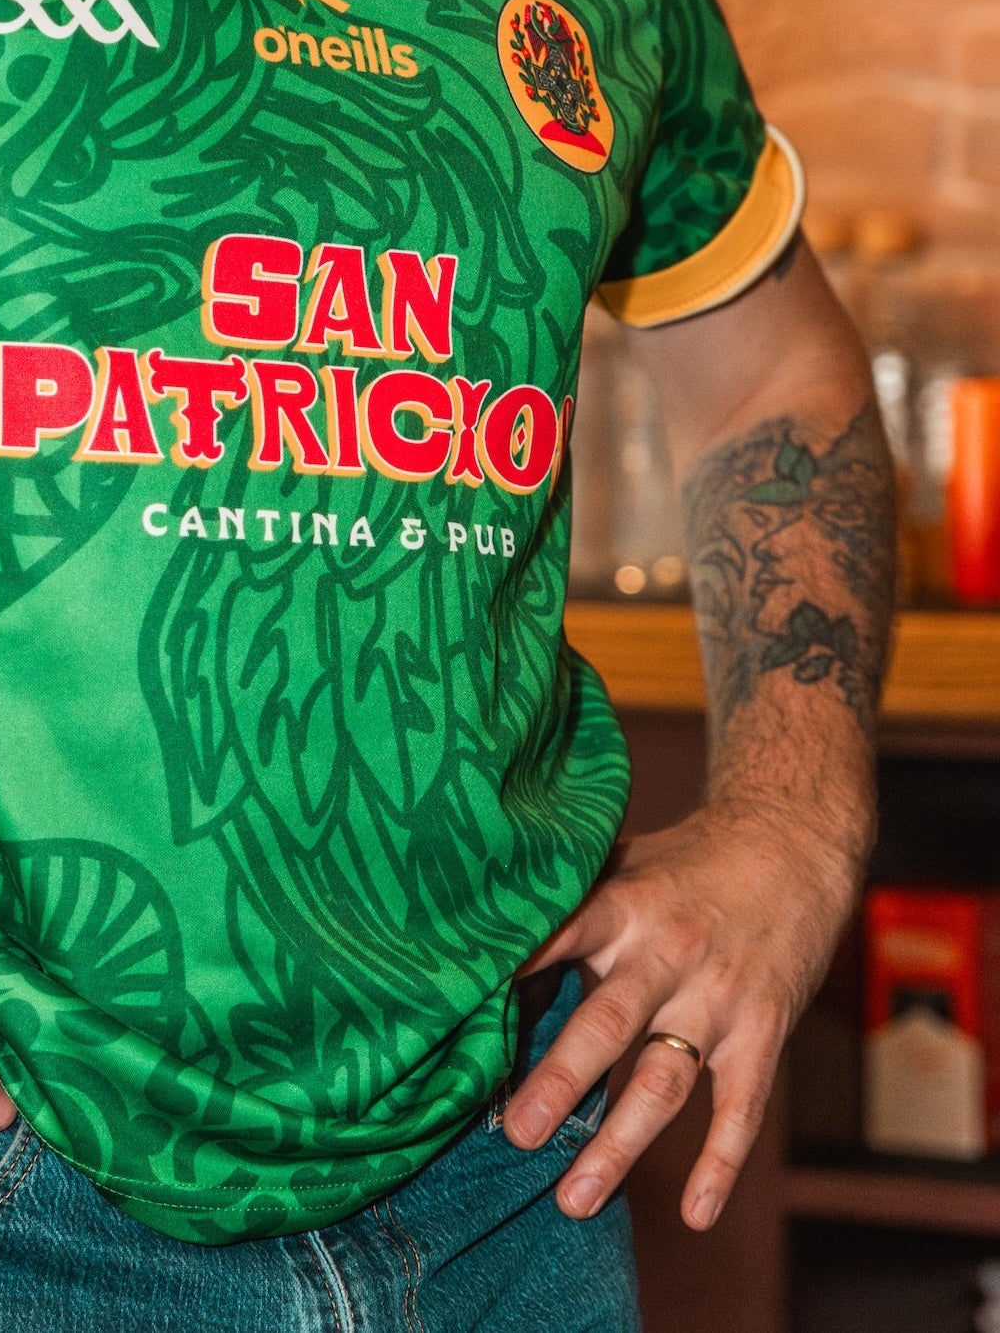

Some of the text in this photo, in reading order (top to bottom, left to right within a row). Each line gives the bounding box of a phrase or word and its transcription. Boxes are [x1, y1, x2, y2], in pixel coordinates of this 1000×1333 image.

[201, 232, 459, 363] SAN
[142, 503, 519, 559] CANTINA & PUB
